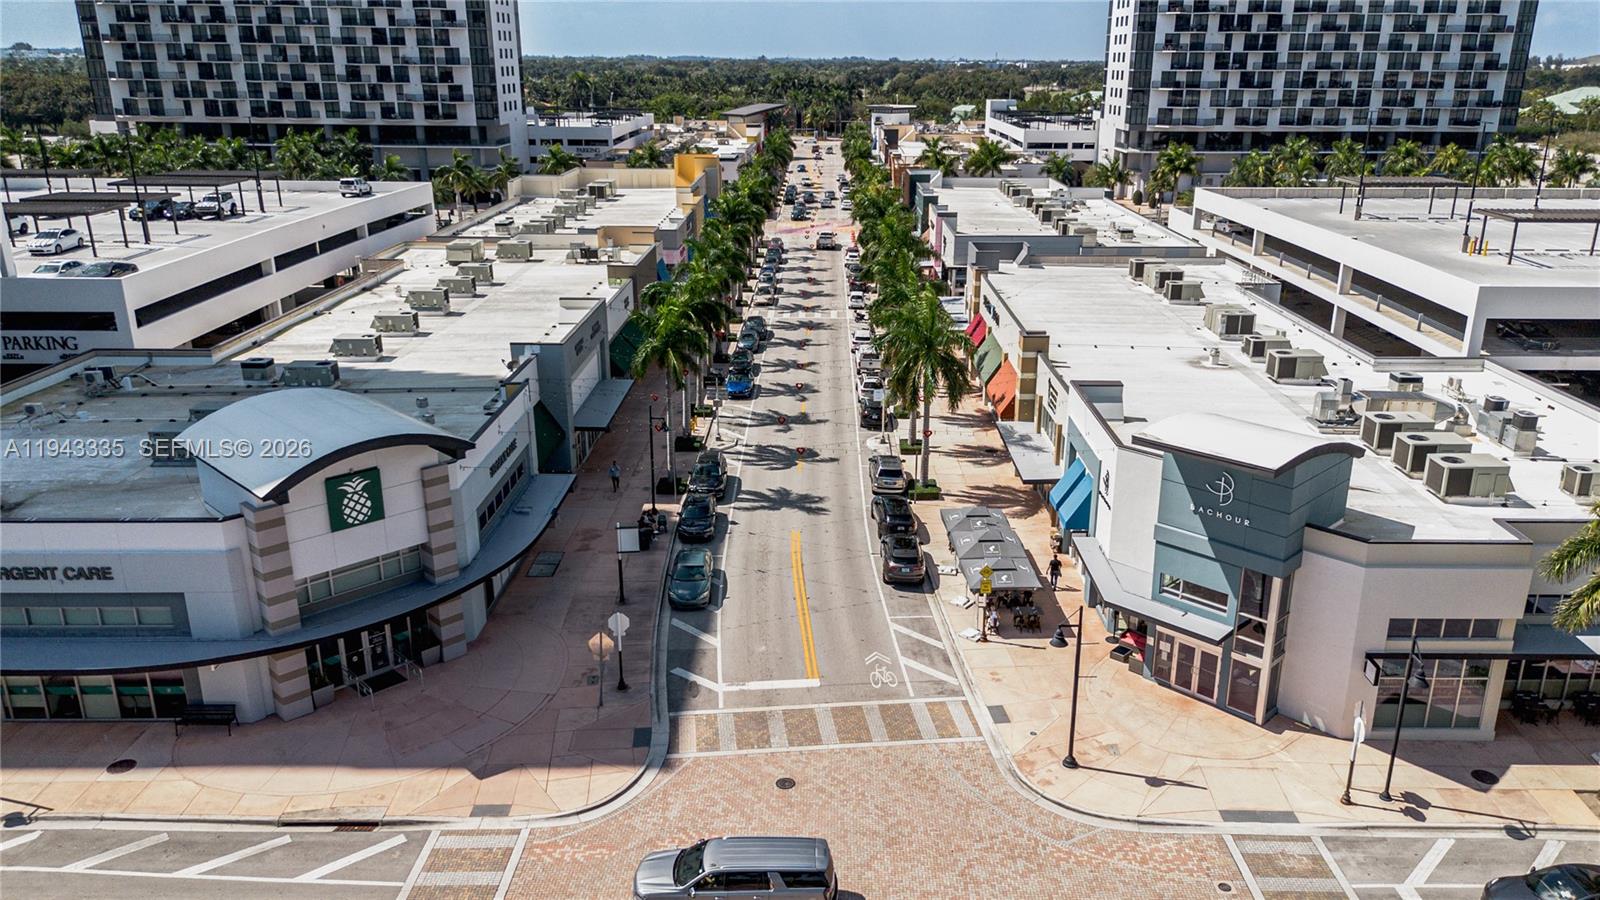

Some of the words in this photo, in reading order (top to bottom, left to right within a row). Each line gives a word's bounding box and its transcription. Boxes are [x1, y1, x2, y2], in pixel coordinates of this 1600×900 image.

[1, 335, 79, 351] PARKING
[1190, 503, 1251, 527] BACHOUR
[62, 566, 115, 581] CARE
